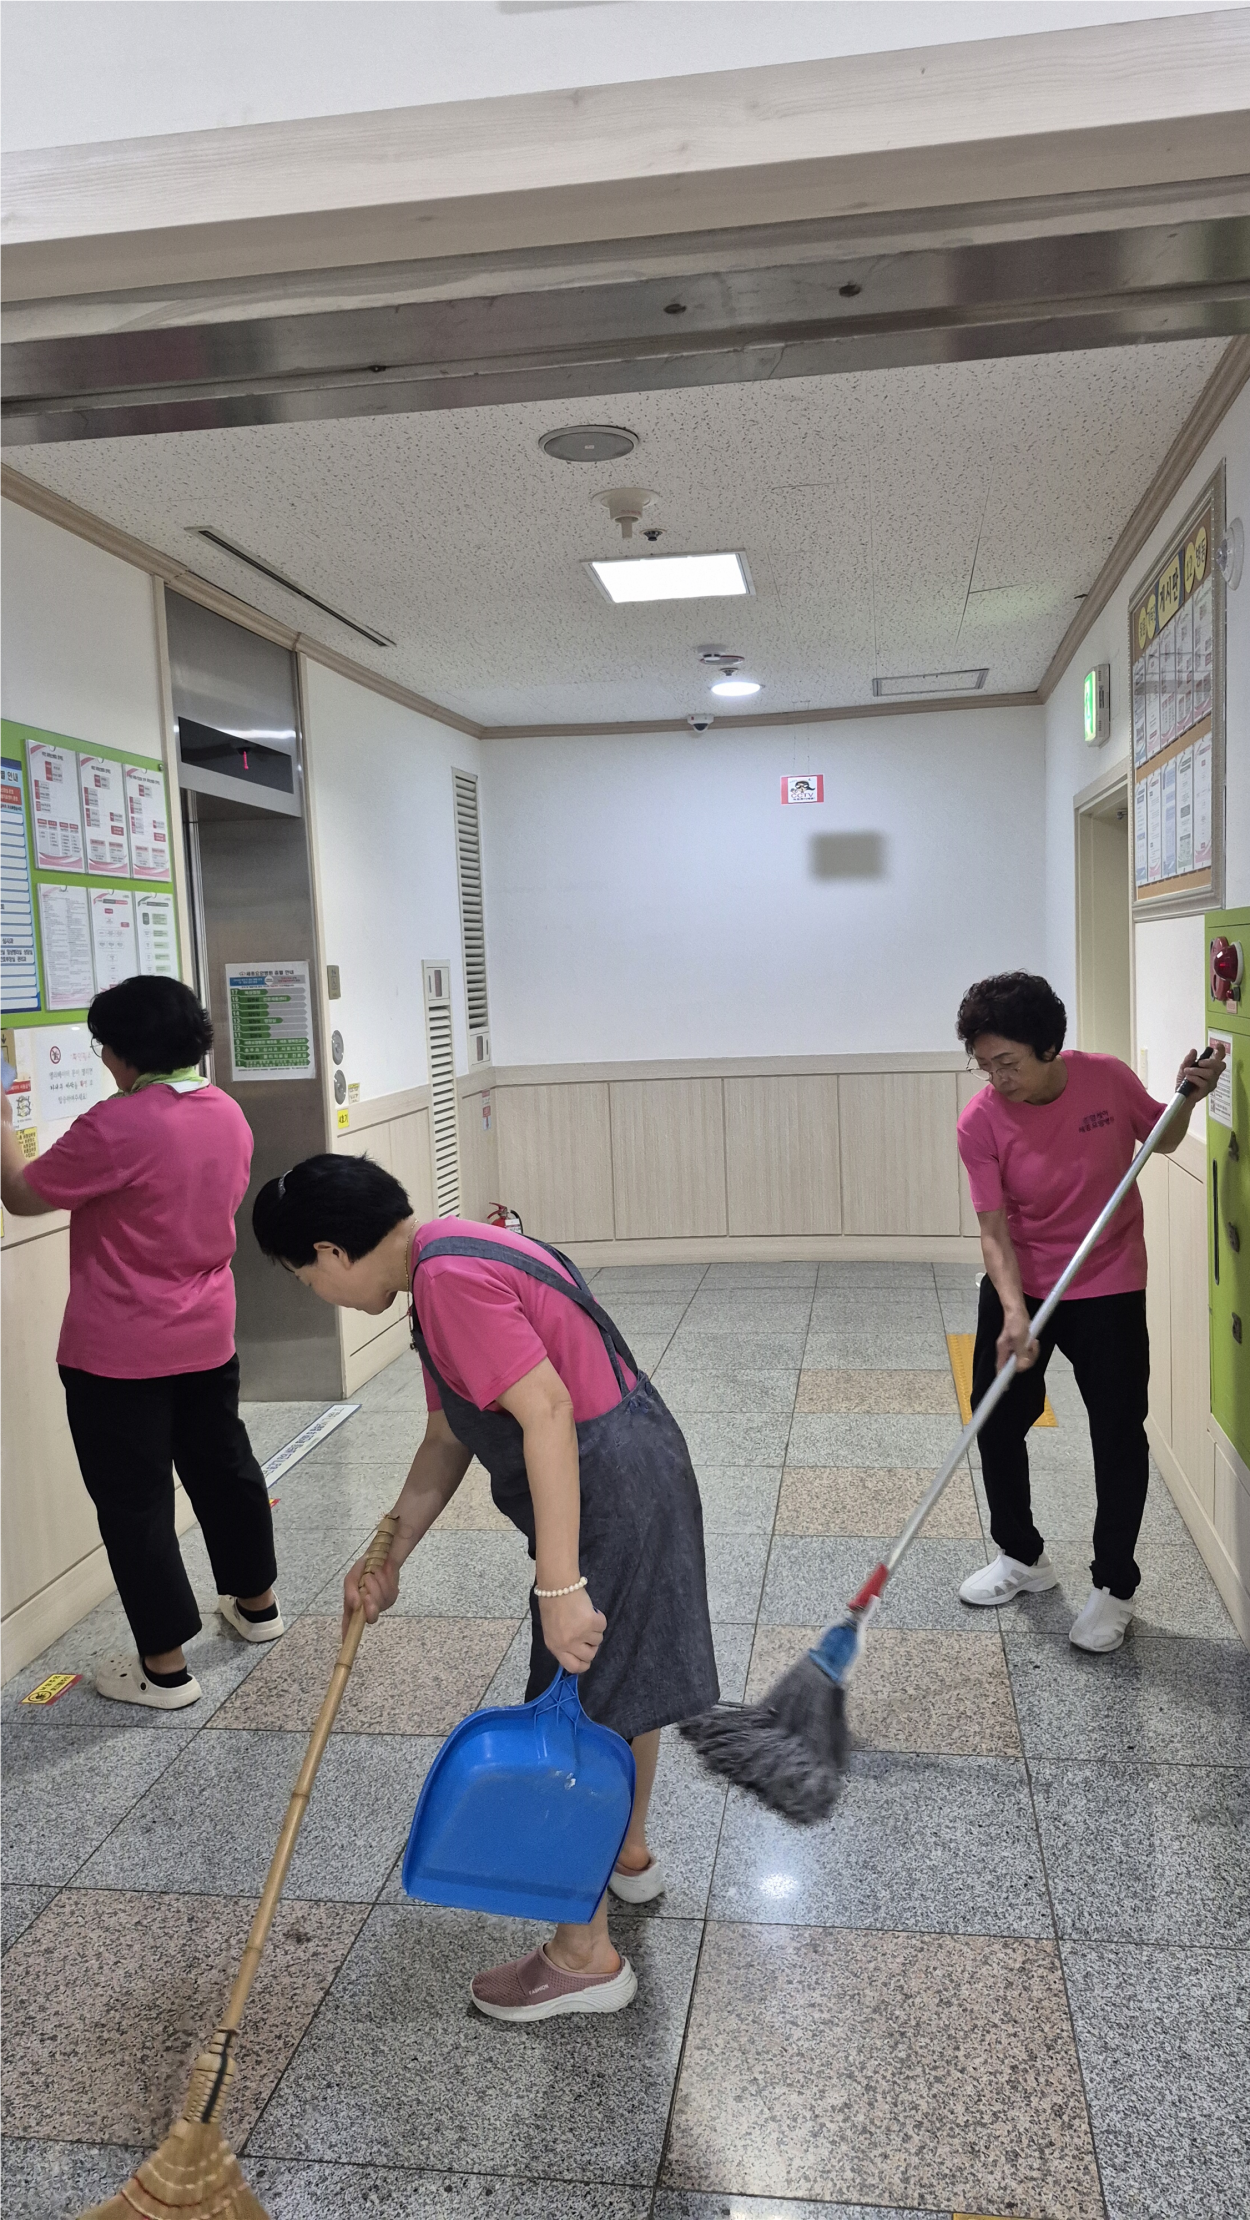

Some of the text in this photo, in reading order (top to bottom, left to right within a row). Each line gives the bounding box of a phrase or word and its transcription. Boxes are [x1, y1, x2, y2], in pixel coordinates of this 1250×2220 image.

[1159, 566, 1179, 612] 게시판
[1185, 554, 1193, 582] 12
[1195, 537, 1206, 567] 병동
[7, 771, 19, 782] 안내
